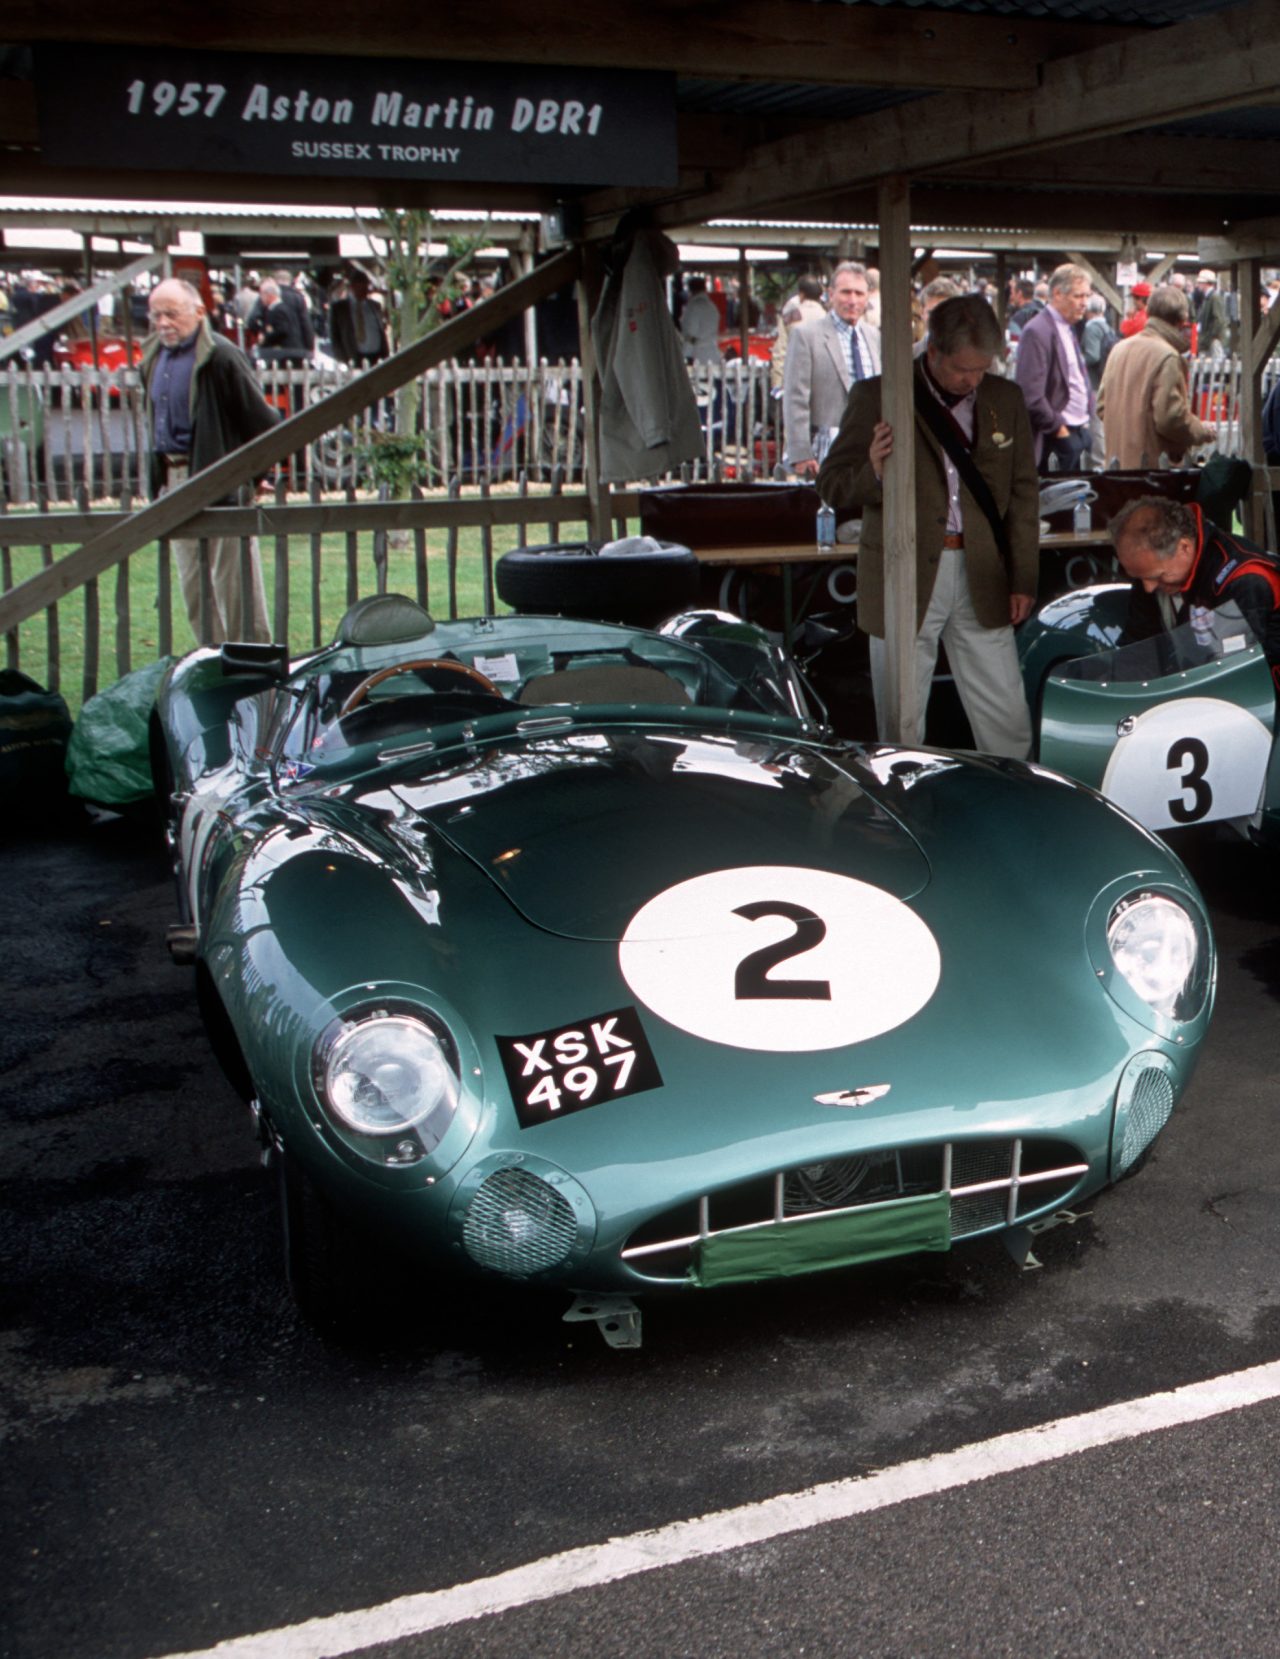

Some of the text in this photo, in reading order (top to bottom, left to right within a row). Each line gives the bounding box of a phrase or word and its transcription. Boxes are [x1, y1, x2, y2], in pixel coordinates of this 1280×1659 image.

[127, 79, 602, 136] 1957 Aston Martin DBR1
[291, 141, 461, 163] SUSSEX TROPHY
[1166, 736, 1213, 823] 3
[730, 900, 832, 1001] 2
[513, 1017, 632, 1077] XSK
[526, 1050, 636, 1111] 497
